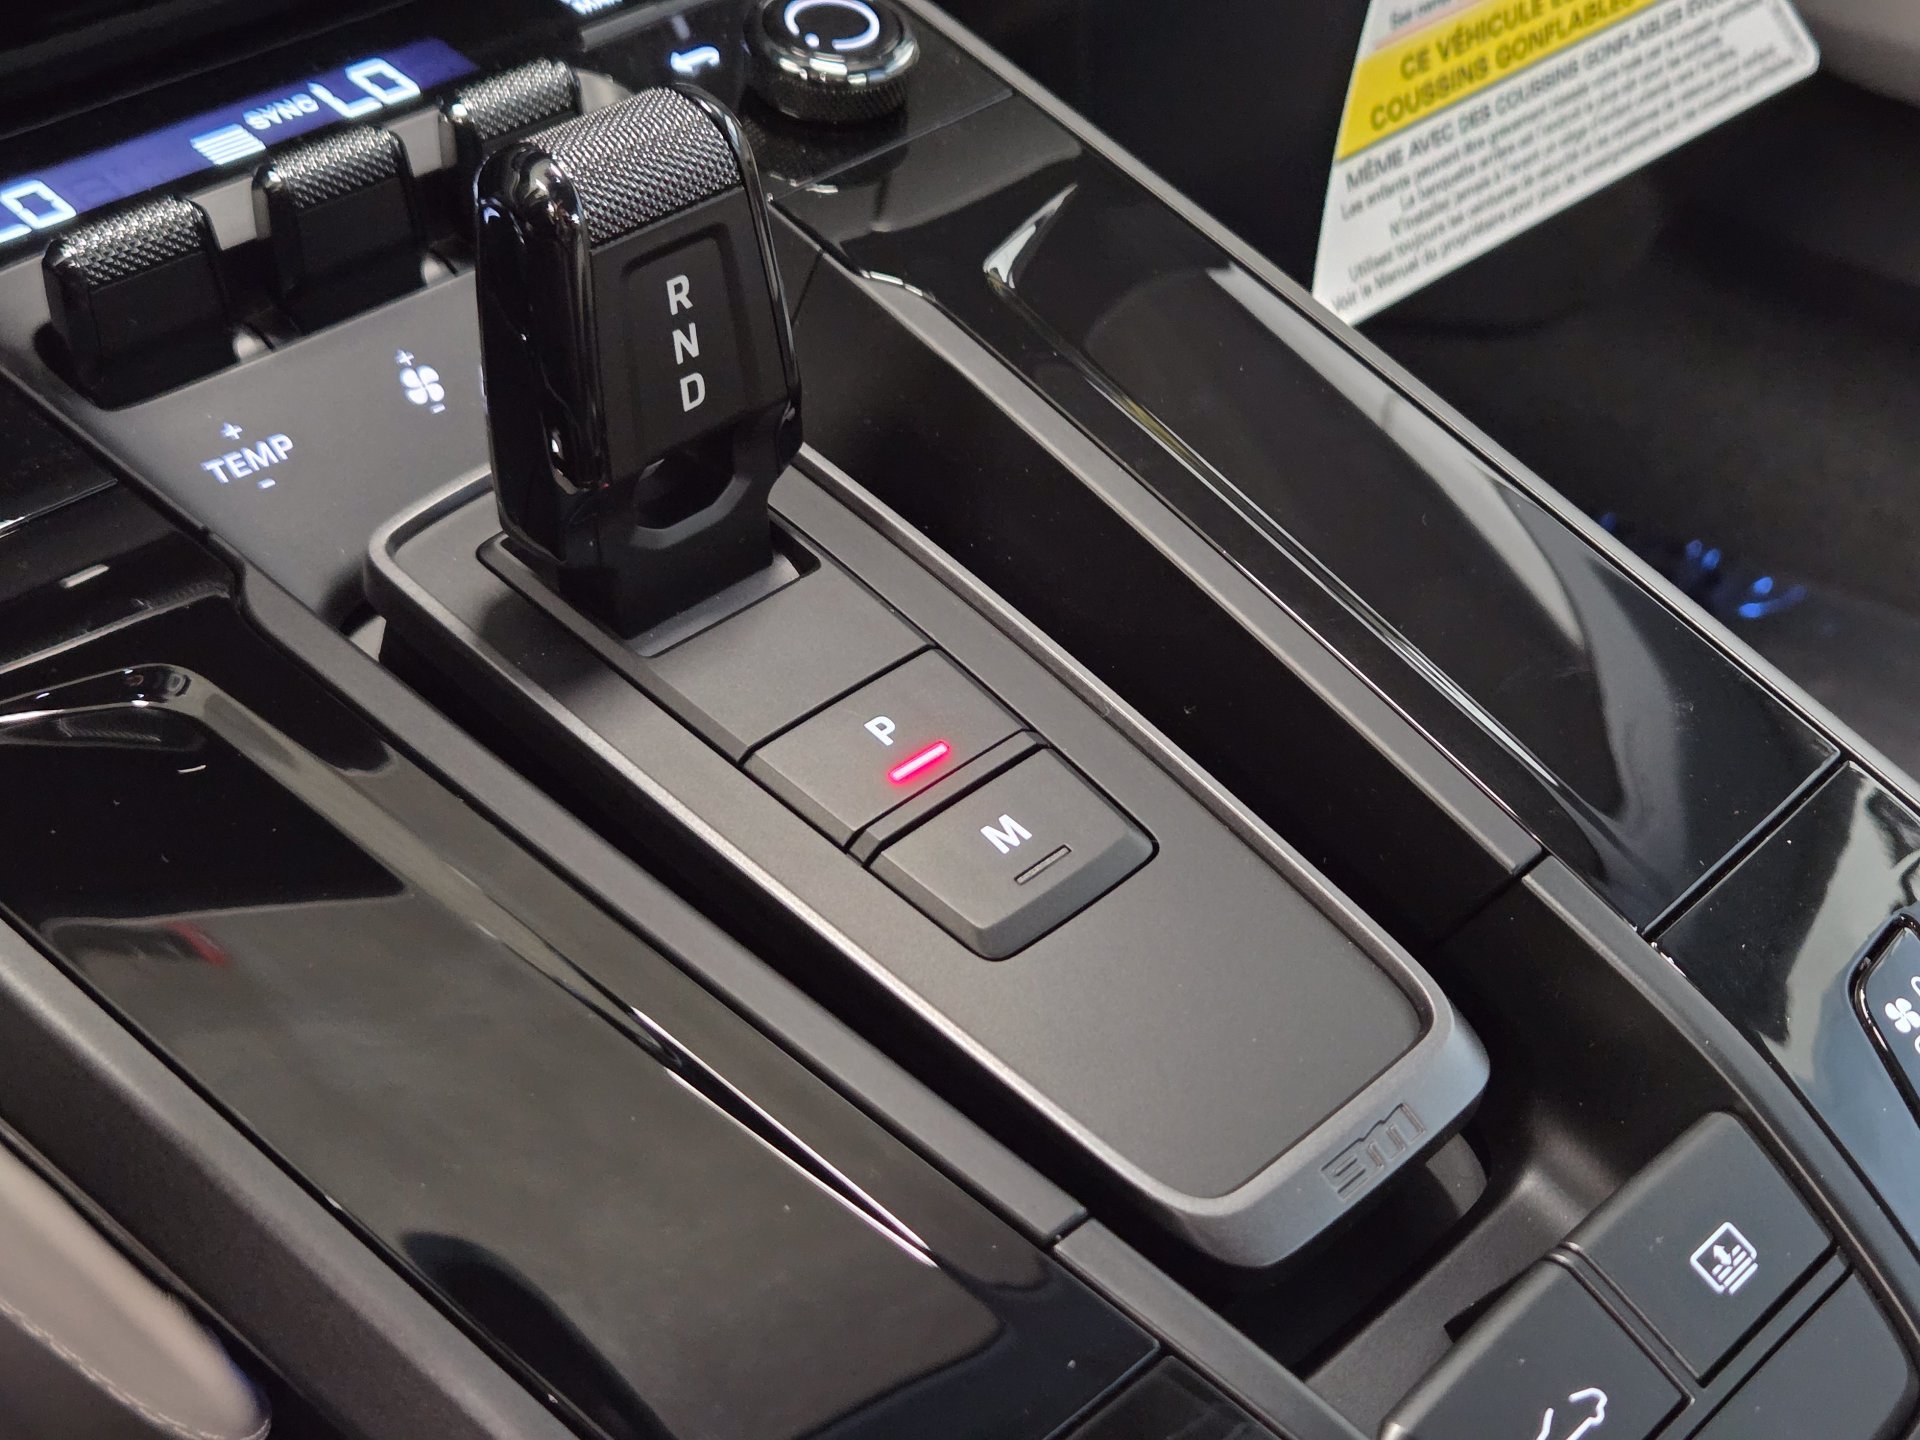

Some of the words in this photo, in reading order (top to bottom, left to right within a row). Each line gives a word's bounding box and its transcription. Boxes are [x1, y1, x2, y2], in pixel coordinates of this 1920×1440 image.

[1401, 46, 1429, 82] CE
[1439, 0, 1542, 63] VÉHICULE
[242, 93, 320, 130] SYNC
[1370, 56, 1487, 132] COUSSINS
[1346, 148, 1401, 191] MÊME
[1406, 122, 1452, 160] AVEC
[1458, 103, 1489, 135] DES
[1495, 59, 1577, 116] COUSSINS
[666, 274, 694, 316] R
[672, 322, 700, 365] N
[680, 372, 706, 412] D
[201, 433, 294, 485] TEMP
[863, 715, 896, 747] P
[980, 813, 1033, 855] M
